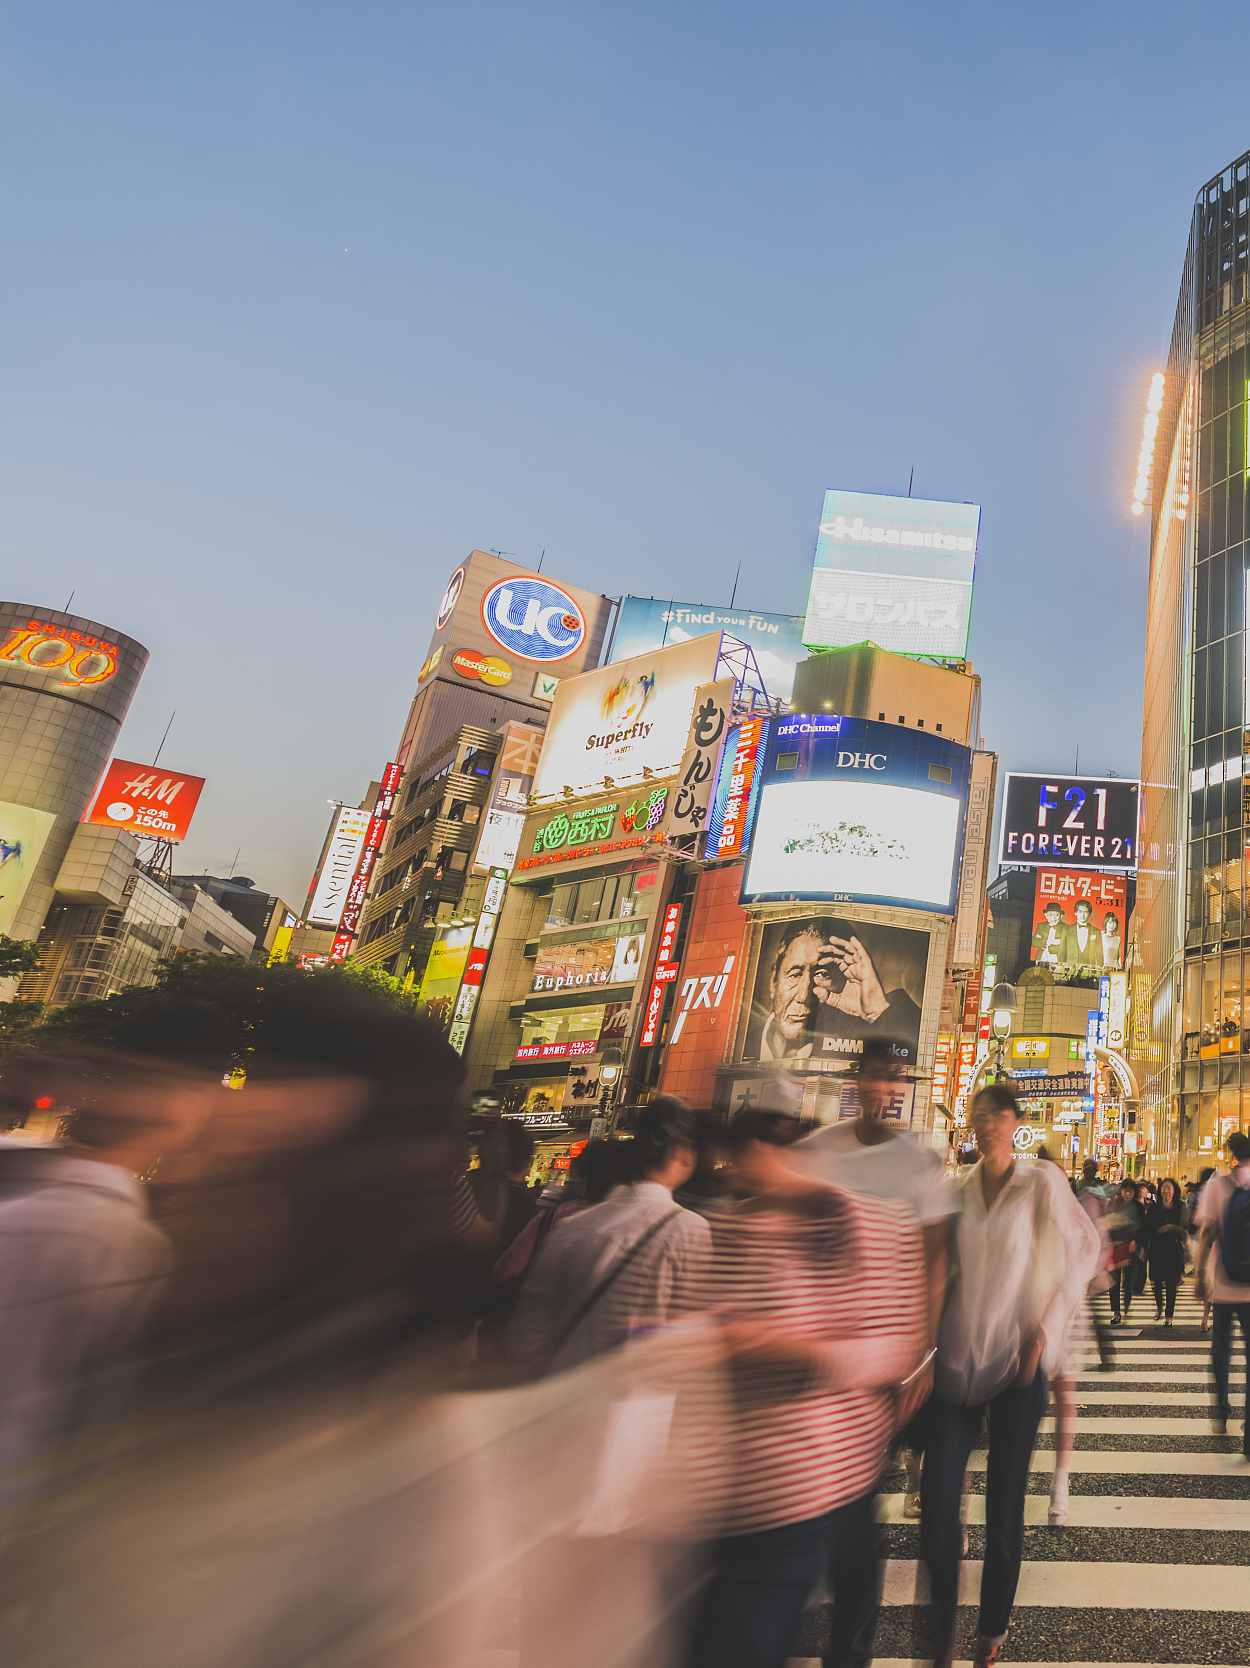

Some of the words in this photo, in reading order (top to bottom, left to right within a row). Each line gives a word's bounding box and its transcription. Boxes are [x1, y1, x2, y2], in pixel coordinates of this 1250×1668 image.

[819, 516, 974, 551] Hisamitsu
[495, 588, 578, 647] UC
[717, 616, 746, 626] YOUR
[748, 615, 779, 634] FUN
[814, 592, 960, 630] サロンパス
[27, 620, 119, 656] SHIBUYA
[0, 629, 117, 686] 109
[453, 655, 512, 680] MasterCard
[585, 721, 655, 751] Superfly
[778, 725, 799, 735] DHC
[800, 723, 841, 733] Channel
[673, 697, 726, 828] もんじゃ
[836, 752, 888, 770] DHC
[121, 772, 186, 806] H&M
[717, 723, 755, 848] 三千里薬品
[137, 806, 170, 820] この先
[1037, 784, 1108, 831] F21
[133, 814, 178, 832] 150m
[566, 813, 616, 846] 西村
[1007, 831, 1105, 858] FOREVER
[1110, 837, 1132, 859] 21
[834, 893, 853, 902] DHC
[1040, 872, 1124, 900] 日本ダービー
[1095, 896, 1120, 907] 5.31
[534, 970, 608, 992] Euphoria
[603, 1008, 631, 1032] JTB
[822, 1036, 865, 1054] DMM
[732, 1086, 906, 1121] 大書店
[525, 1114, 565, 1125] フルーツパー
